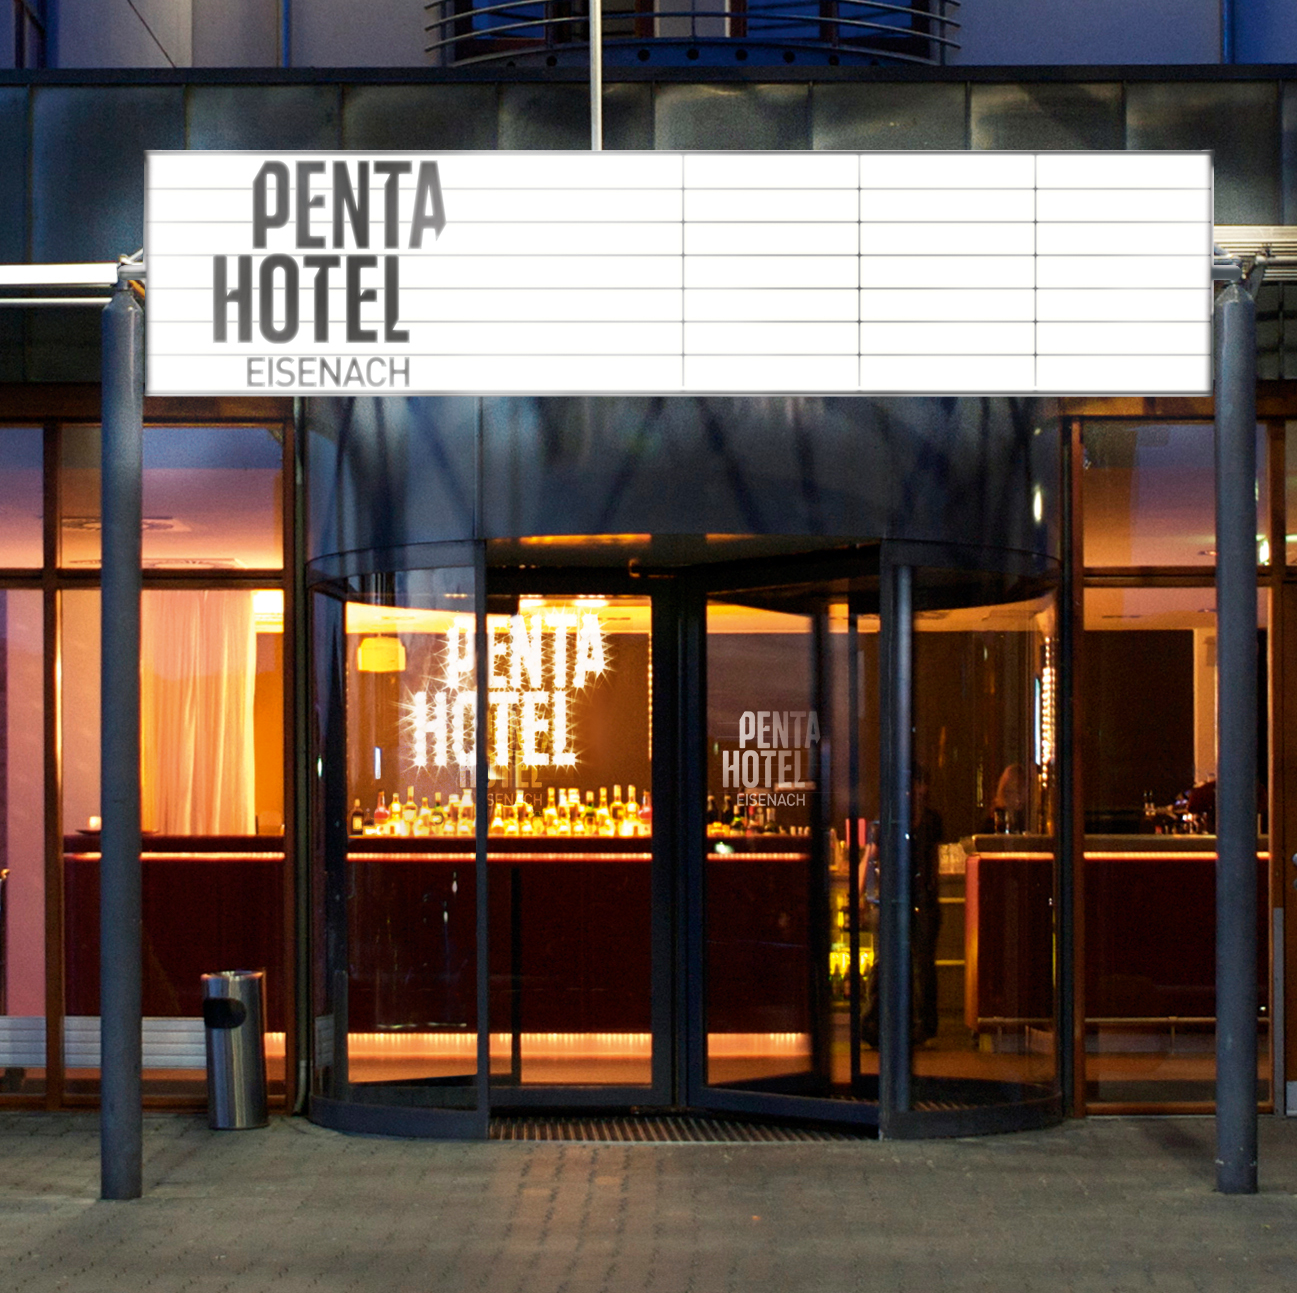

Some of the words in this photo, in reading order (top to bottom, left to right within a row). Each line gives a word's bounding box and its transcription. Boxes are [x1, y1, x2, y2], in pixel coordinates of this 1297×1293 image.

[252, 160, 447, 249] PENTA
[212, 252, 410, 344] HOTEL
[246, 356, 410, 388] EISENACH
[445, 613, 607, 689] PENTA
[413, 690, 576, 767] HOTEL
[739, 710, 821, 749] PENTA
[722, 750, 806, 789] HOTEL
[736, 793, 806, 807] EISENACH
